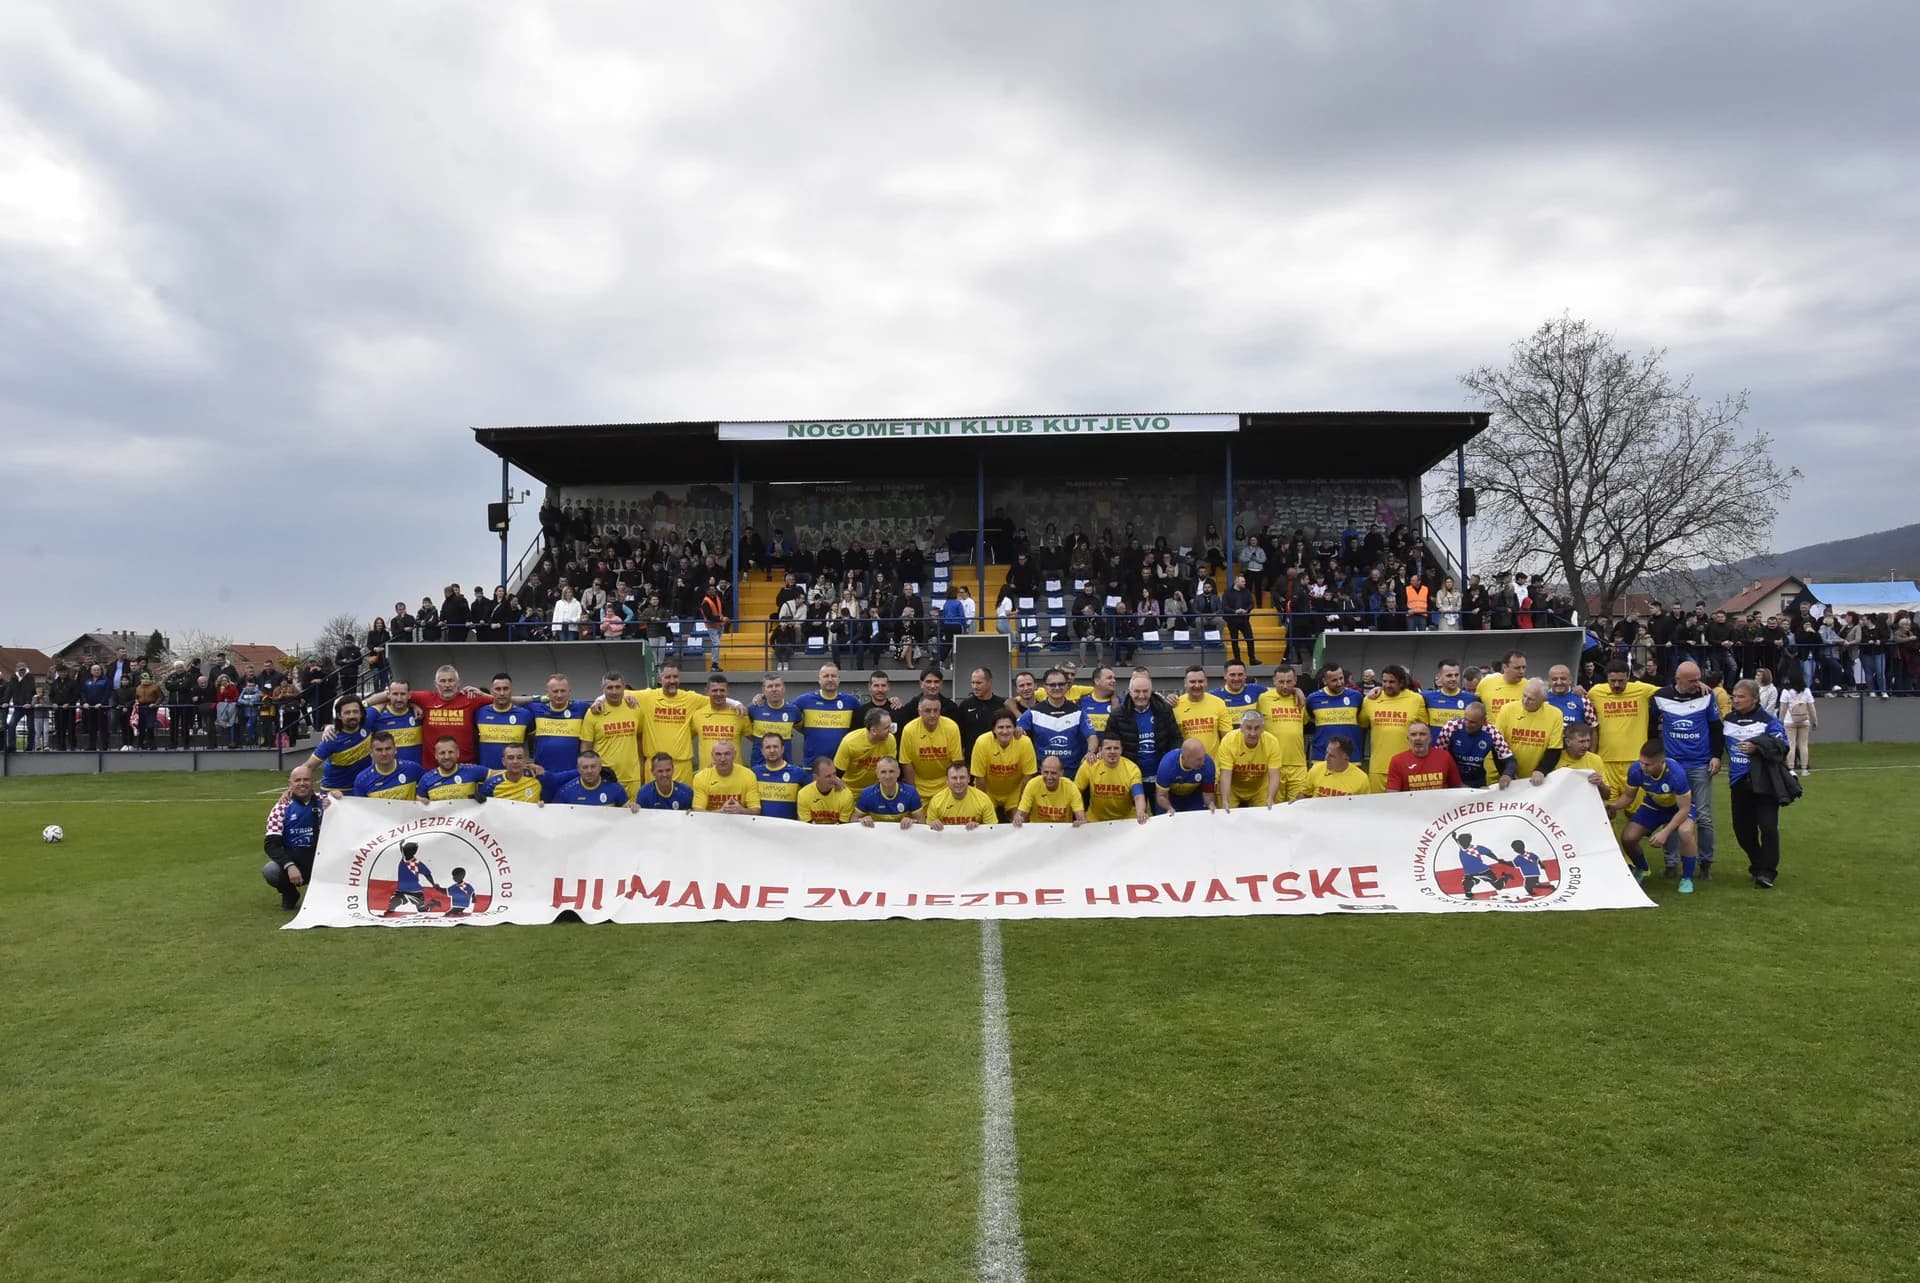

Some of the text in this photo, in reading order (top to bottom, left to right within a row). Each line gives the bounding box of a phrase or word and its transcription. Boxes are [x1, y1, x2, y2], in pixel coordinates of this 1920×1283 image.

[787, 417, 1170, 437] NOGOMETNI KLUB KUTJEVO
[1604, 701, 1638, 709] MIKI
[655, 707, 686, 715] MIKI
[1272, 707, 1302, 715] MIKI
[603, 721, 635, 731] MIKI
[1182, 717, 1215, 727] MIKI
[702, 725, 734, 733] MIKI
[1512, 728, 1545, 738] MIKI
[1408, 772, 1443, 783] MIKI
[1318, 786, 1351, 796] MIK
[1413, 801, 1576, 882] HUMANE ZVIJEZDE HRVATSKE 03
[349, 816, 513, 898] HUMANE ZVIJEZDE HRVATSKE 03
[552, 865, 1385, 909] HUMANE ZVIJEZDE HRVATSKE
